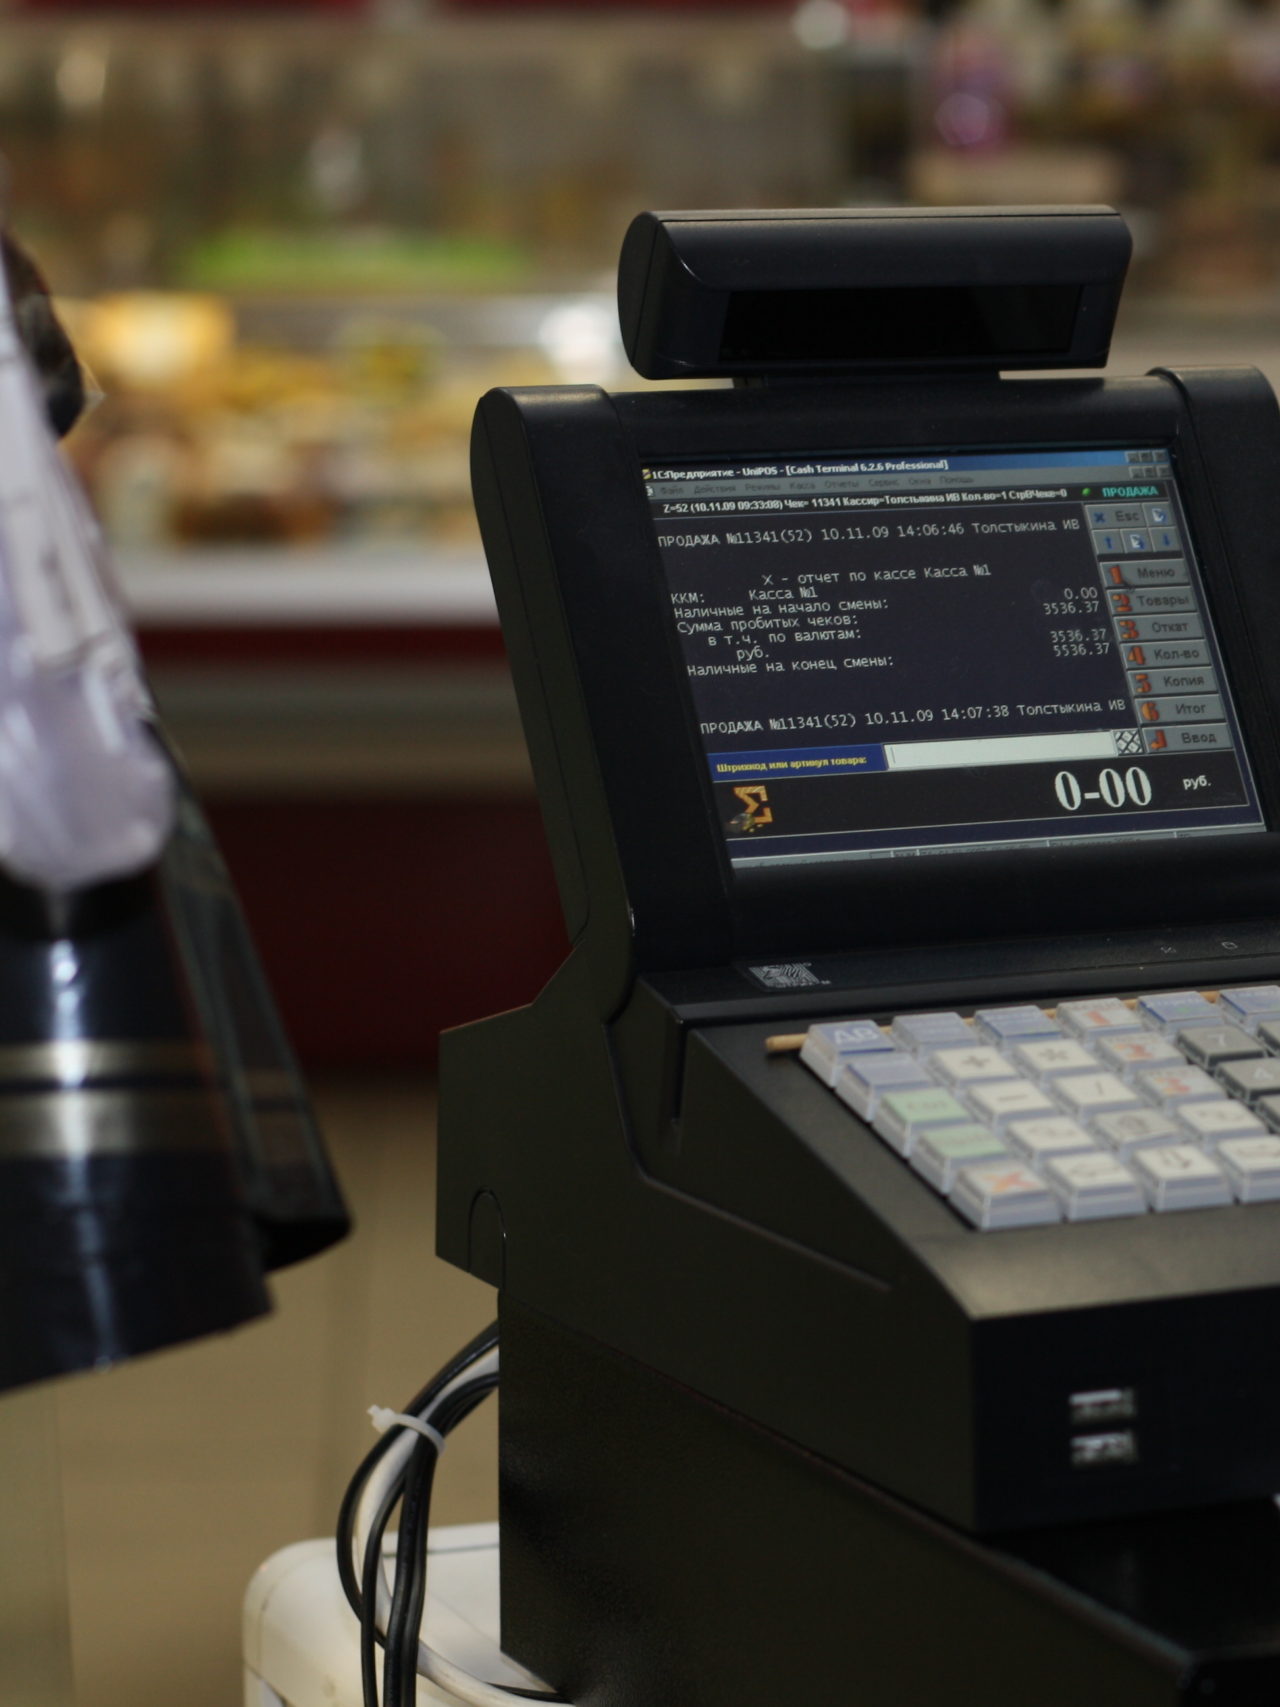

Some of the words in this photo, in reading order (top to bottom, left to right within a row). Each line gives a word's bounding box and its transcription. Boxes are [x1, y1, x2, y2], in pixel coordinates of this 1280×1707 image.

[743, 467, 778, 476] UniPOS
[786, 465, 813, 475] [Cash
[816, 463, 859, 473] Terminal
[886, 459, 949, 470] Professional]
[946, 492, 960, 502] ИВ
[1102, 485, 1159, 497] ПРОДАЖА
[1116, 510, 1140, 521] Esc
[658, 535, 720, 548] ПРОДАЖА
[821, 526, 889, 541] 10.11.09
[897, 522, 964, 538] 14:06:46
[972, 520, 1056, 533] Толстыкина
[1063, 519, 1079, 530] ИВ
[798, 572, 839, 584] отчет
[849, 571, 866, 581] по
[874, 568, 916, 580] кассе
[924, 567, 967, 578] Касса
[973, 564, 991, 576] №1
[1137, 566, 1175, 579] Меню
[671, 593, 705, 604] ККМ:
[749, 588, 793, 600] Касса
[800, 587, 818, 598] №1
[675, 605, 744, 618] Наличные
[753, 606, 770, 615] на
[779, 603, 830, 613] начало
[839, 599, 889, 611] смены:
[1064, 587, 1097, 599] 0.00
[1139, 596, 1189, 608] Товары
[677, 621, 723, 635] Сумма
[731, 617, 799, 631] пробитых
[808, 614, 858, 626] чеков:
[1043, 601, 1099, 615] 3536.37
[1152, 621, 1189, 633] Откат
[708, 636, 716, 646] в
[769, 634, 786, 643] по
[795, 628, 861, 641] валютам:
[737, 646, 769, 661] руб.
[1050, 628, 1107, 643] 3536.37
[687, 662, 757, 676] Наличные
[766, 662, 784, 672] на
[792, 659, 837, 671] конец
[843, 656, 894, 668] смены:
[1052, 643, 1110, 657] 5536.37
[1154, 649, 1200, 661] Кол-во
[1164, 675, 1205, 687] Копия
[700, 721, 763, 735] ПРОДАЖА
[865, 710, 933, 725] 10.11.09
[942, 705, 1010, 721] 14:07:38
[1018, 700, 1102, 716] Толстыкина
[1108, 699, 1126, 711] ИВ
[1175, 703, 1206, 716] Итог
[1182, 731, 1217, 744] Ввод
[769, 762, 788, 770] или
[790, 759, 829, 770] артикул
[831, 757, 867, 767] товара:
[1054, 766, 1152, 812] 0-00
[1182, 776, 1212, 790] руб.
